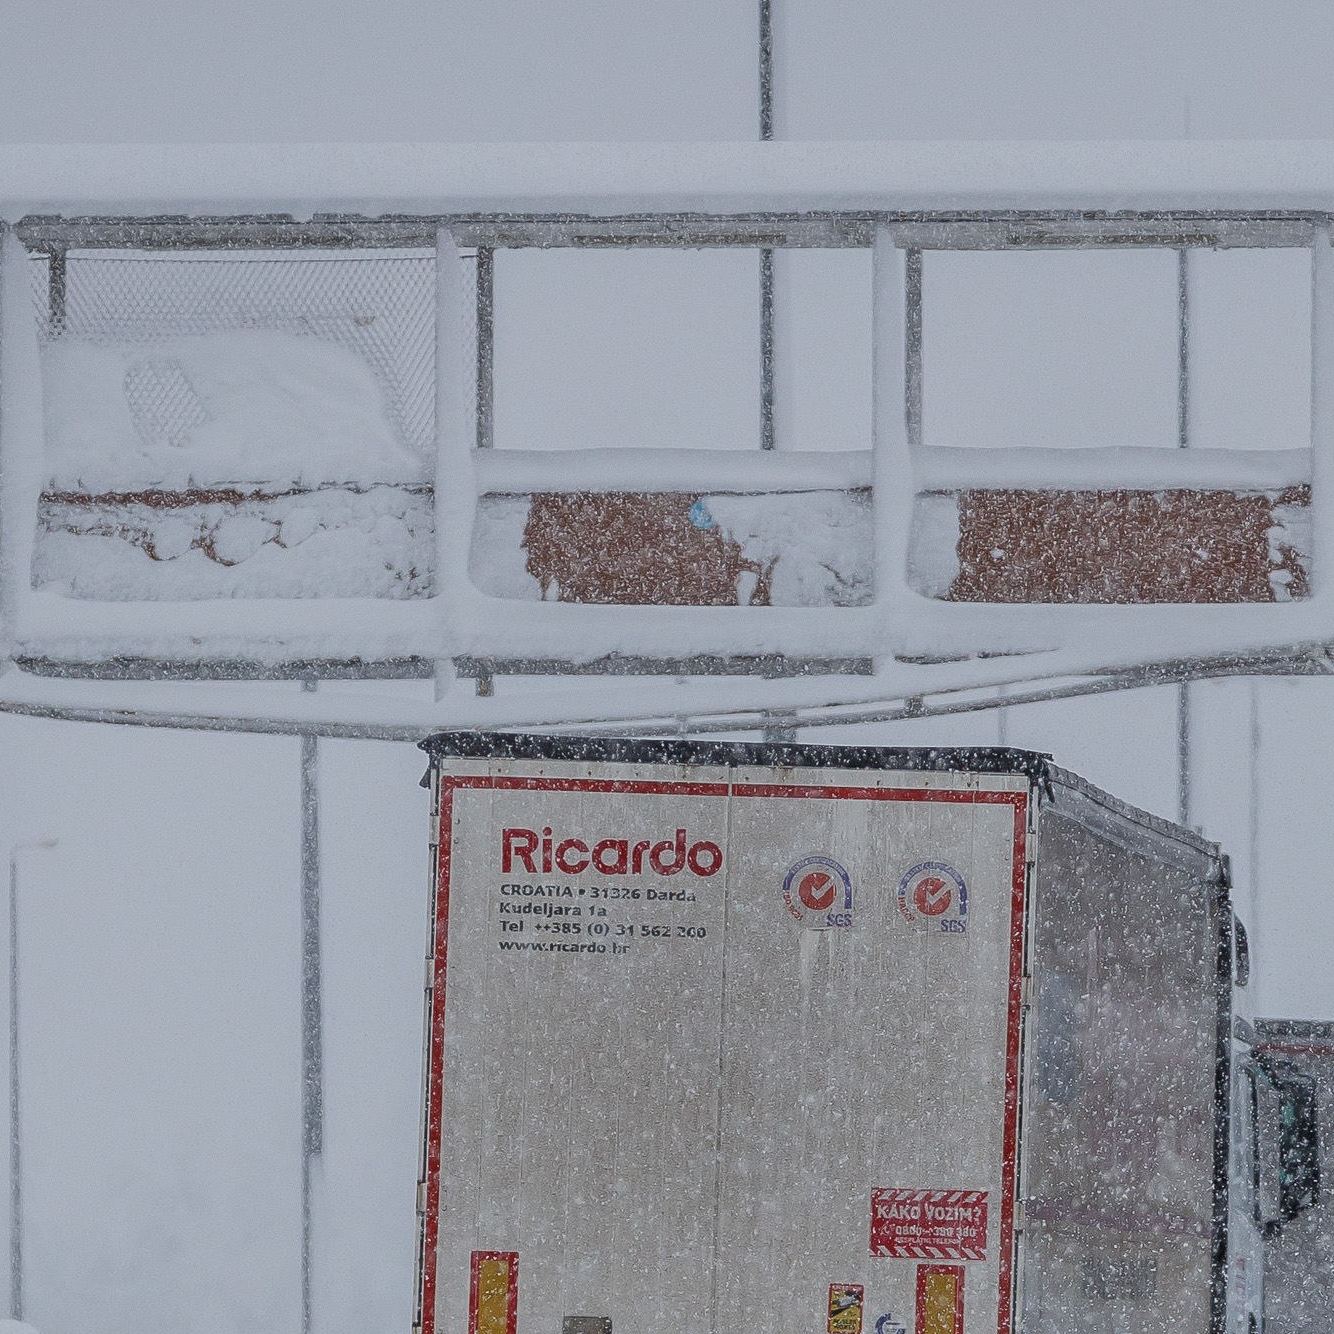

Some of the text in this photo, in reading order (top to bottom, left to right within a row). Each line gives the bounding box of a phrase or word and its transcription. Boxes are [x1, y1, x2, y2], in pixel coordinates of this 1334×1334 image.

[501, 827, 723, 876] Ricardo
[500, 884, 696, 902] CROATIA 31326 Darda
[499, 902, 607, 918] Kudeljara 1a
[826, 913, 852, 927] SGS
[941, 919, 966, 933] SGS
[534, 922, 582, 934] ++385
[587, 922, 610, 937] (0)
[615, 924, 634, 936] 31
[641, 925, 672, 938] 562
[498, 940, 630, 954] www.ricardo.hr
[877, 1203, 982, 1223] KAKO VOZIM?
